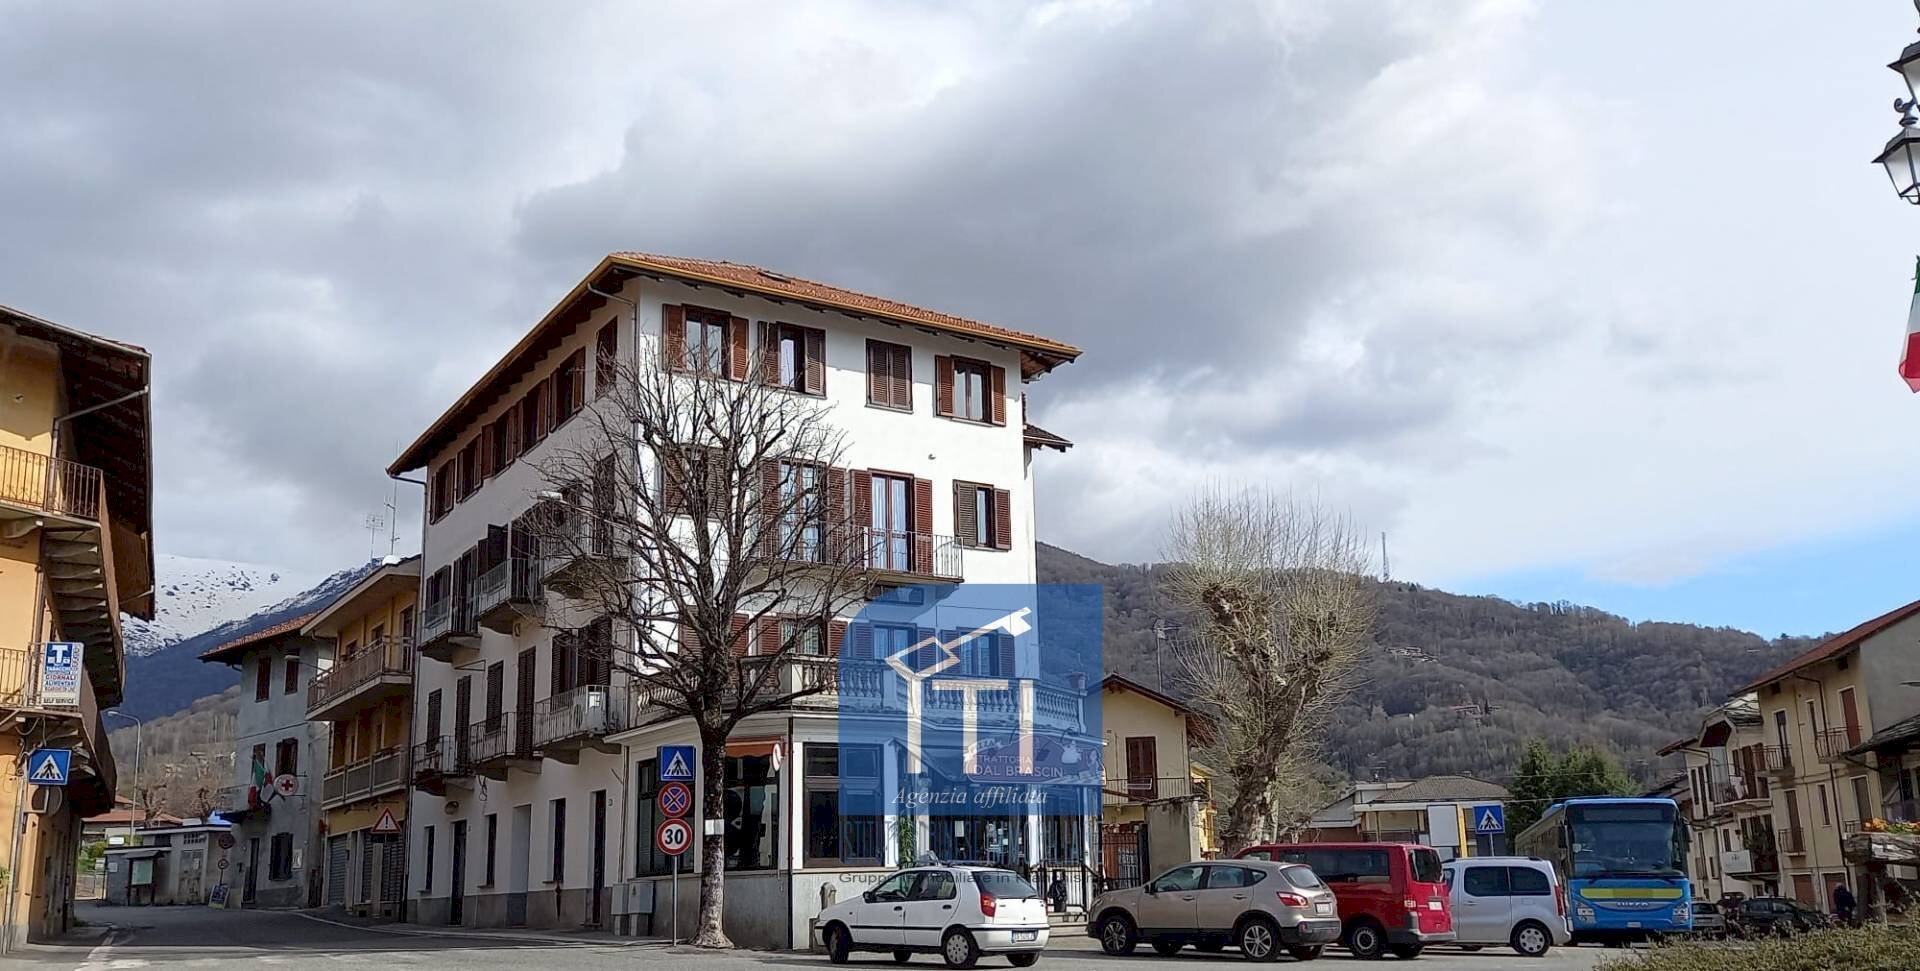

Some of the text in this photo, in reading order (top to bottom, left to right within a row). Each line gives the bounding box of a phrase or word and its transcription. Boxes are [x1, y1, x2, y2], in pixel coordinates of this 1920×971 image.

[978, 755, 1033, 765] TRATTORIA
[973, 765, 1064, 778] DAL BRASCIN
[665, 828, 683, 845] 30
